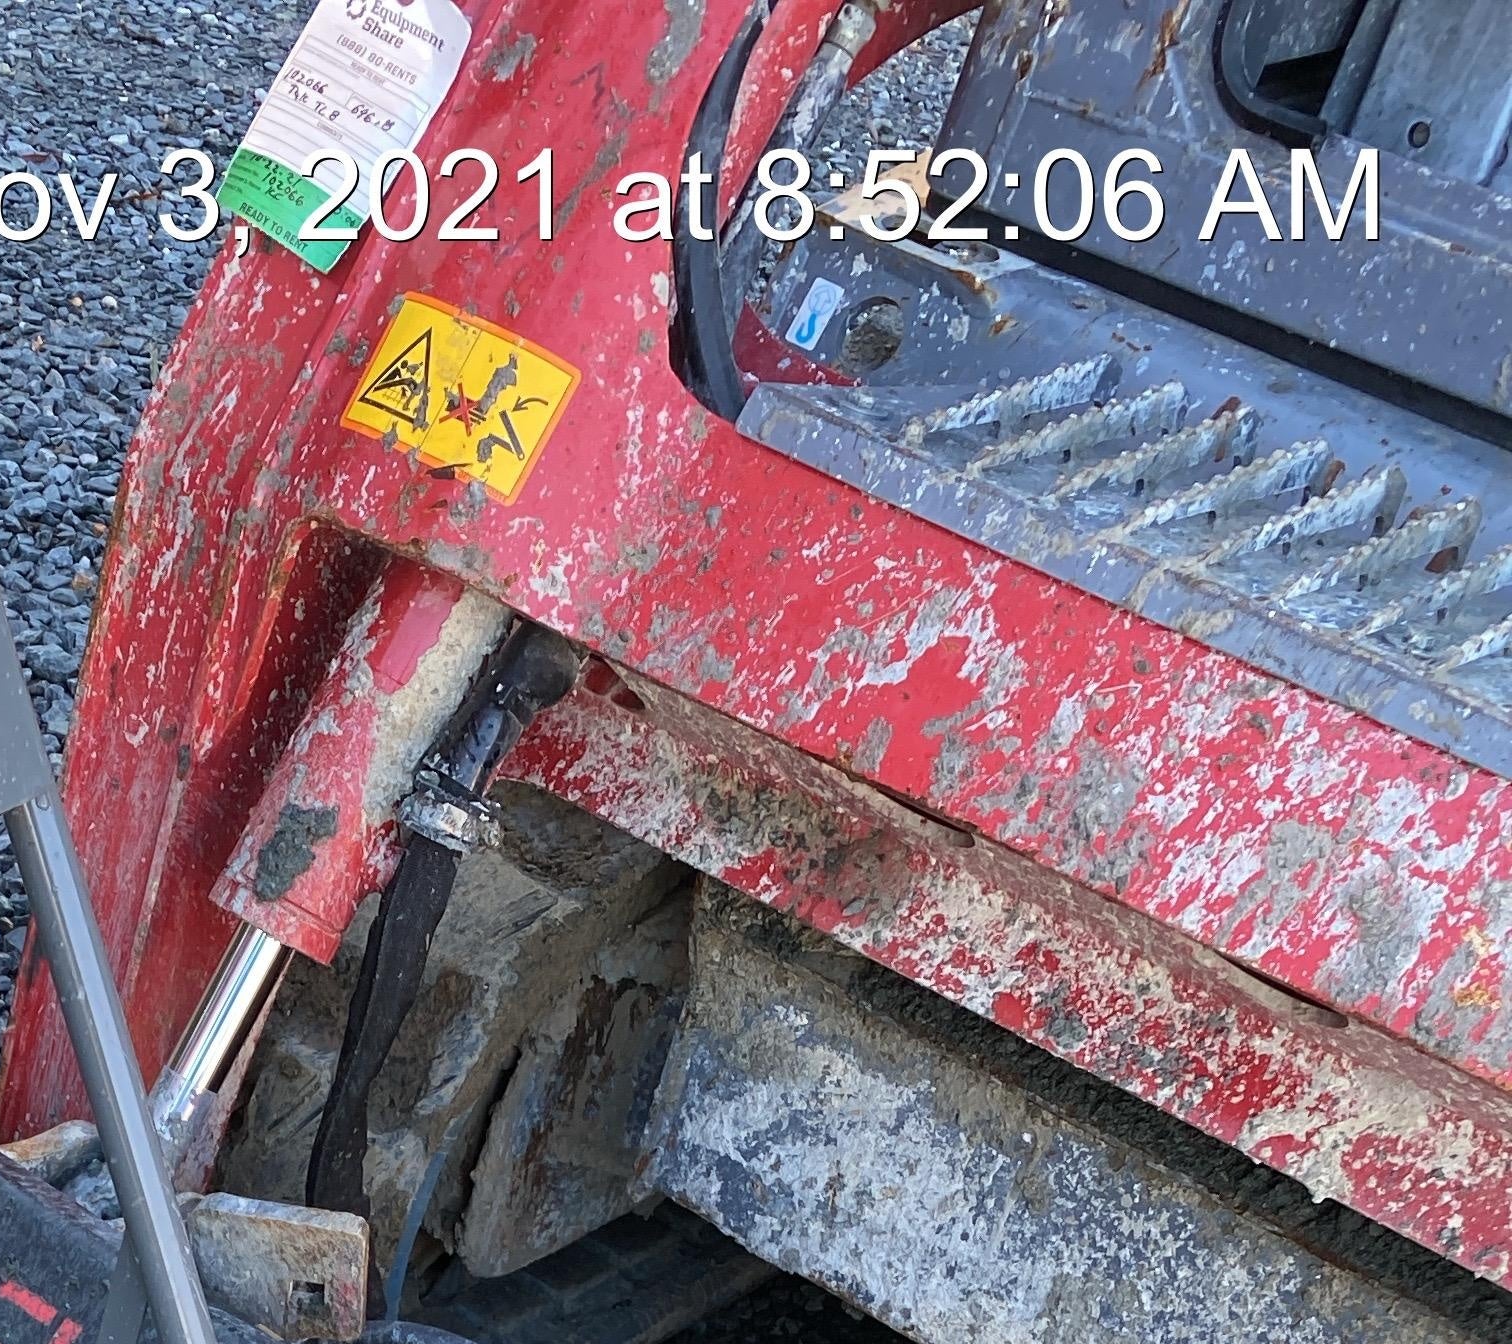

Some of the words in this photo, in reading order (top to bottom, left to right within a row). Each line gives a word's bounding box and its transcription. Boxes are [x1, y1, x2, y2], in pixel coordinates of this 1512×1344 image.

[361, 17, 404, 49] Share
[370, 0, 446, 52] Equipment
[239, 202, 270, 227] READY
[270, 220, 284, 237] TO
